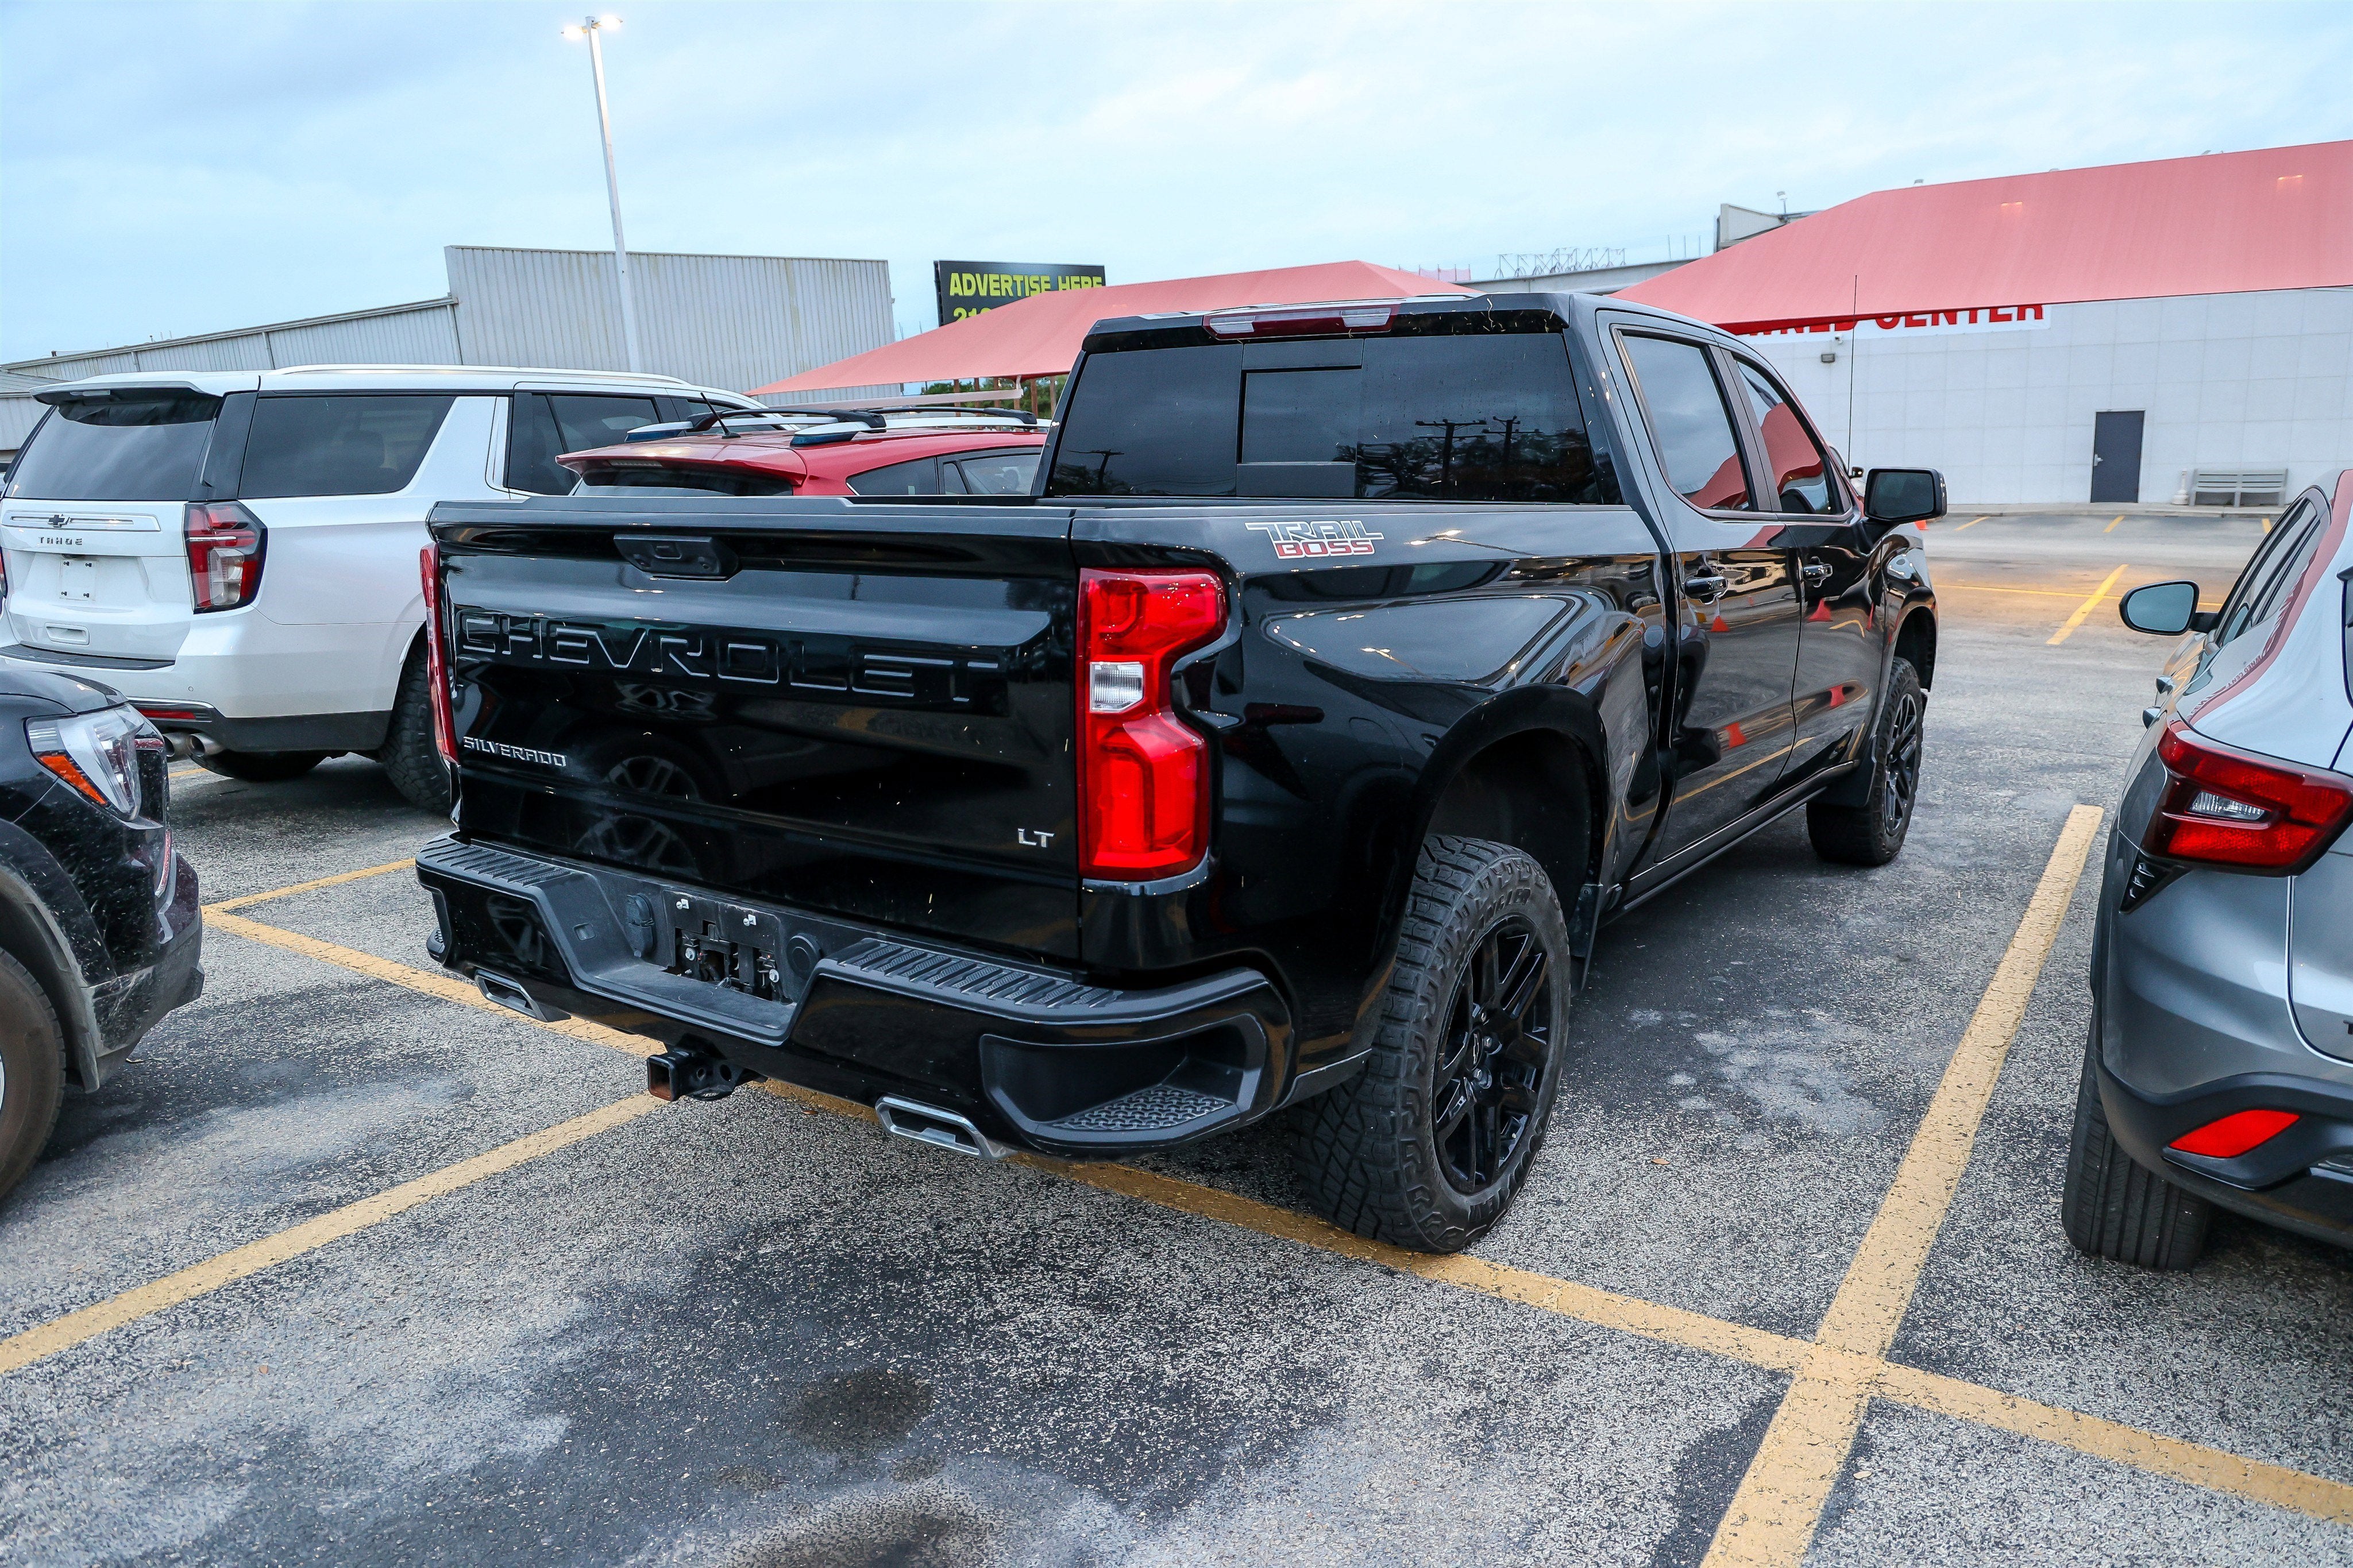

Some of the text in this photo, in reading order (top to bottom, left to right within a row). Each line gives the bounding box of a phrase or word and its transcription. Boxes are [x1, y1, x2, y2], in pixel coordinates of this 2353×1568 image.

[950, 272, 1051, 297] ADVERTISE
[38, 536, 83, 546] TAHOE
[1244, 520, 1385, 541] TRAIL
[1274, 539, 1375, 559] BOSS
[461, 614, 1000, 703] CHEVROLET
[463, 736, 568, 767] SILVERADO
[1017, 828, 1055, 848] LT
